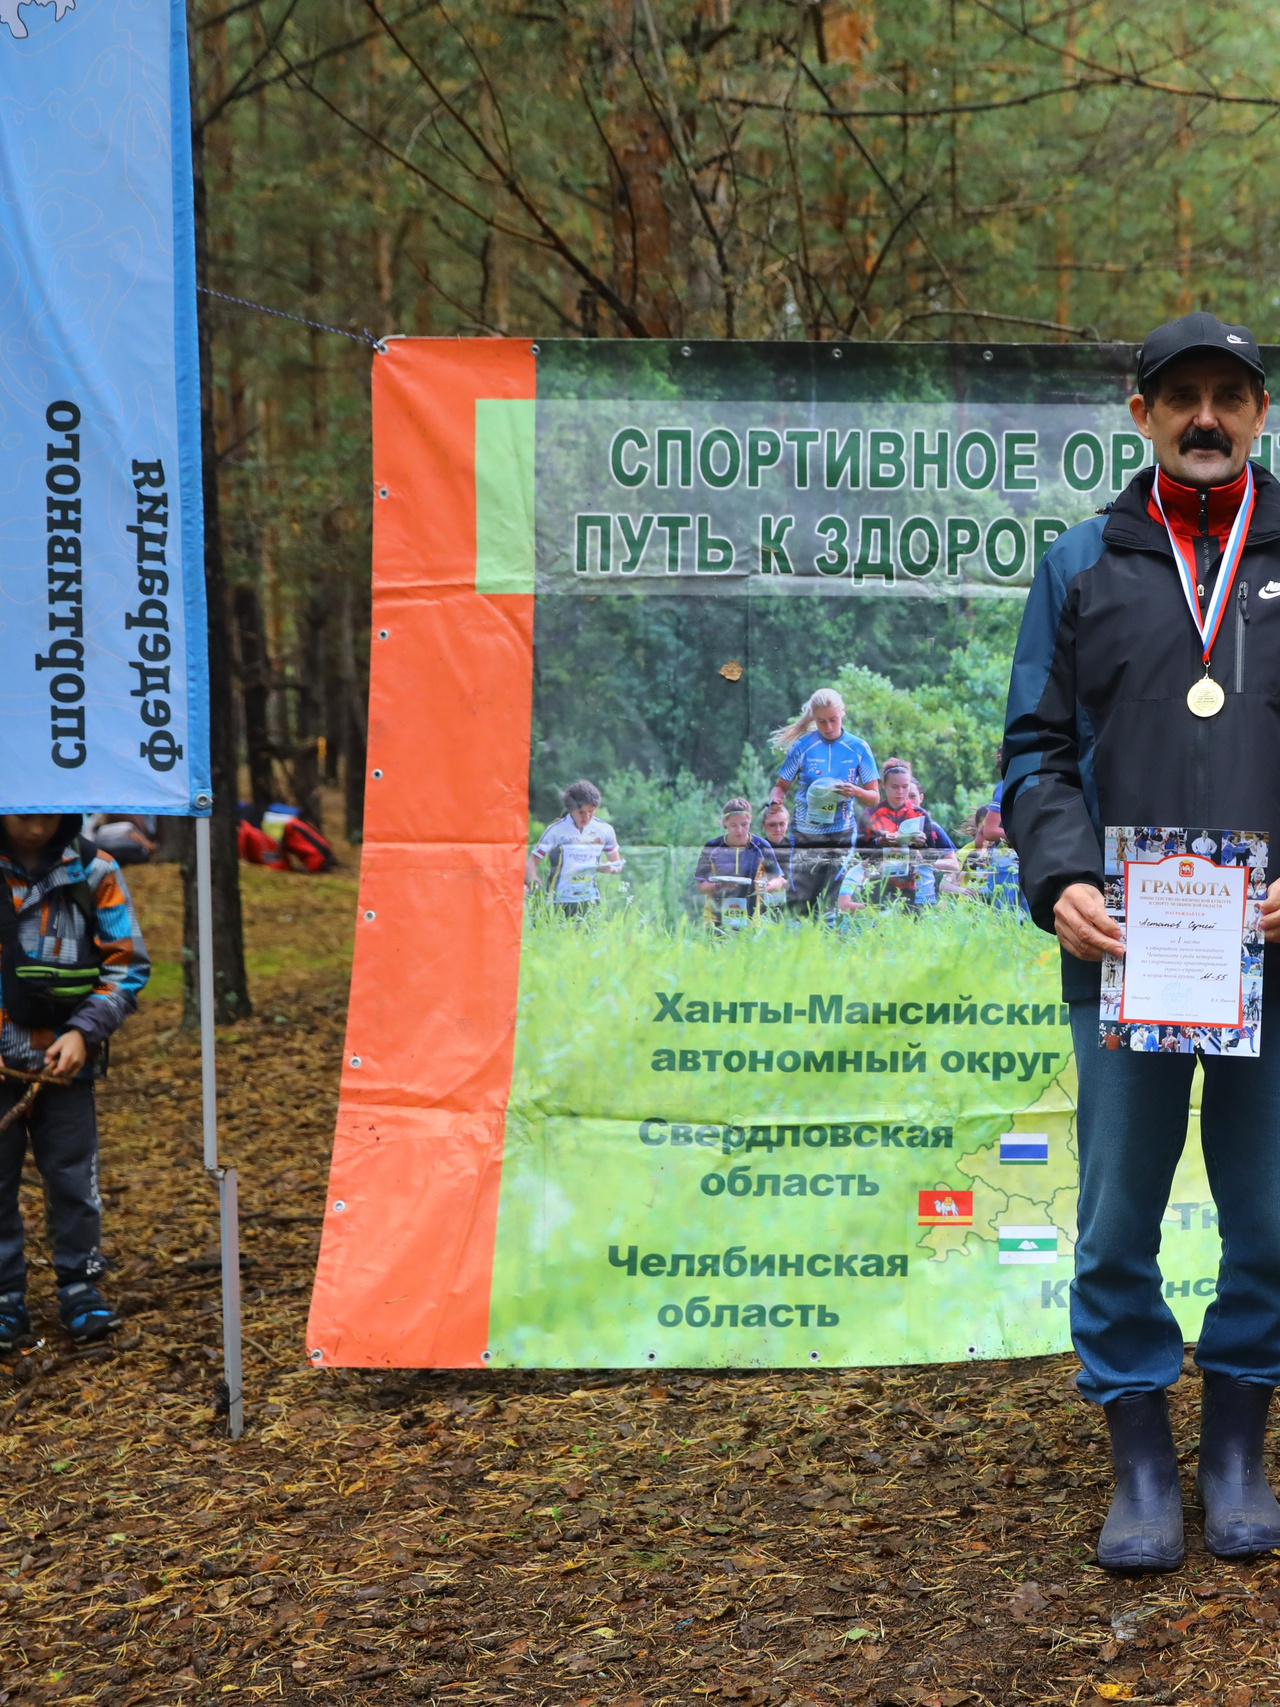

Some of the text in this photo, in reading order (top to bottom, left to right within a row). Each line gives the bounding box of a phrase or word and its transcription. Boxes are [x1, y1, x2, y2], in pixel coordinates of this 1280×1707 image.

[610, 427, 1039, 492] СПОРТИВНОЕ
[575, 514, 734, 574] ПУТЬ
[759, 515, 794, 574] К
[814, 515, 1069, 586] ЗДОРОВ
[1140, 878, 1231, 896] ГРАМОТА
[651, 1042, 1060, 1082] автономный округ
[639, 1117, 953, 1154] Свердловская
[700, 1165, 880, 1197] область
[607, 1245, 909, 1277] Челябинская
[657, 1296, 840, 1328] область
